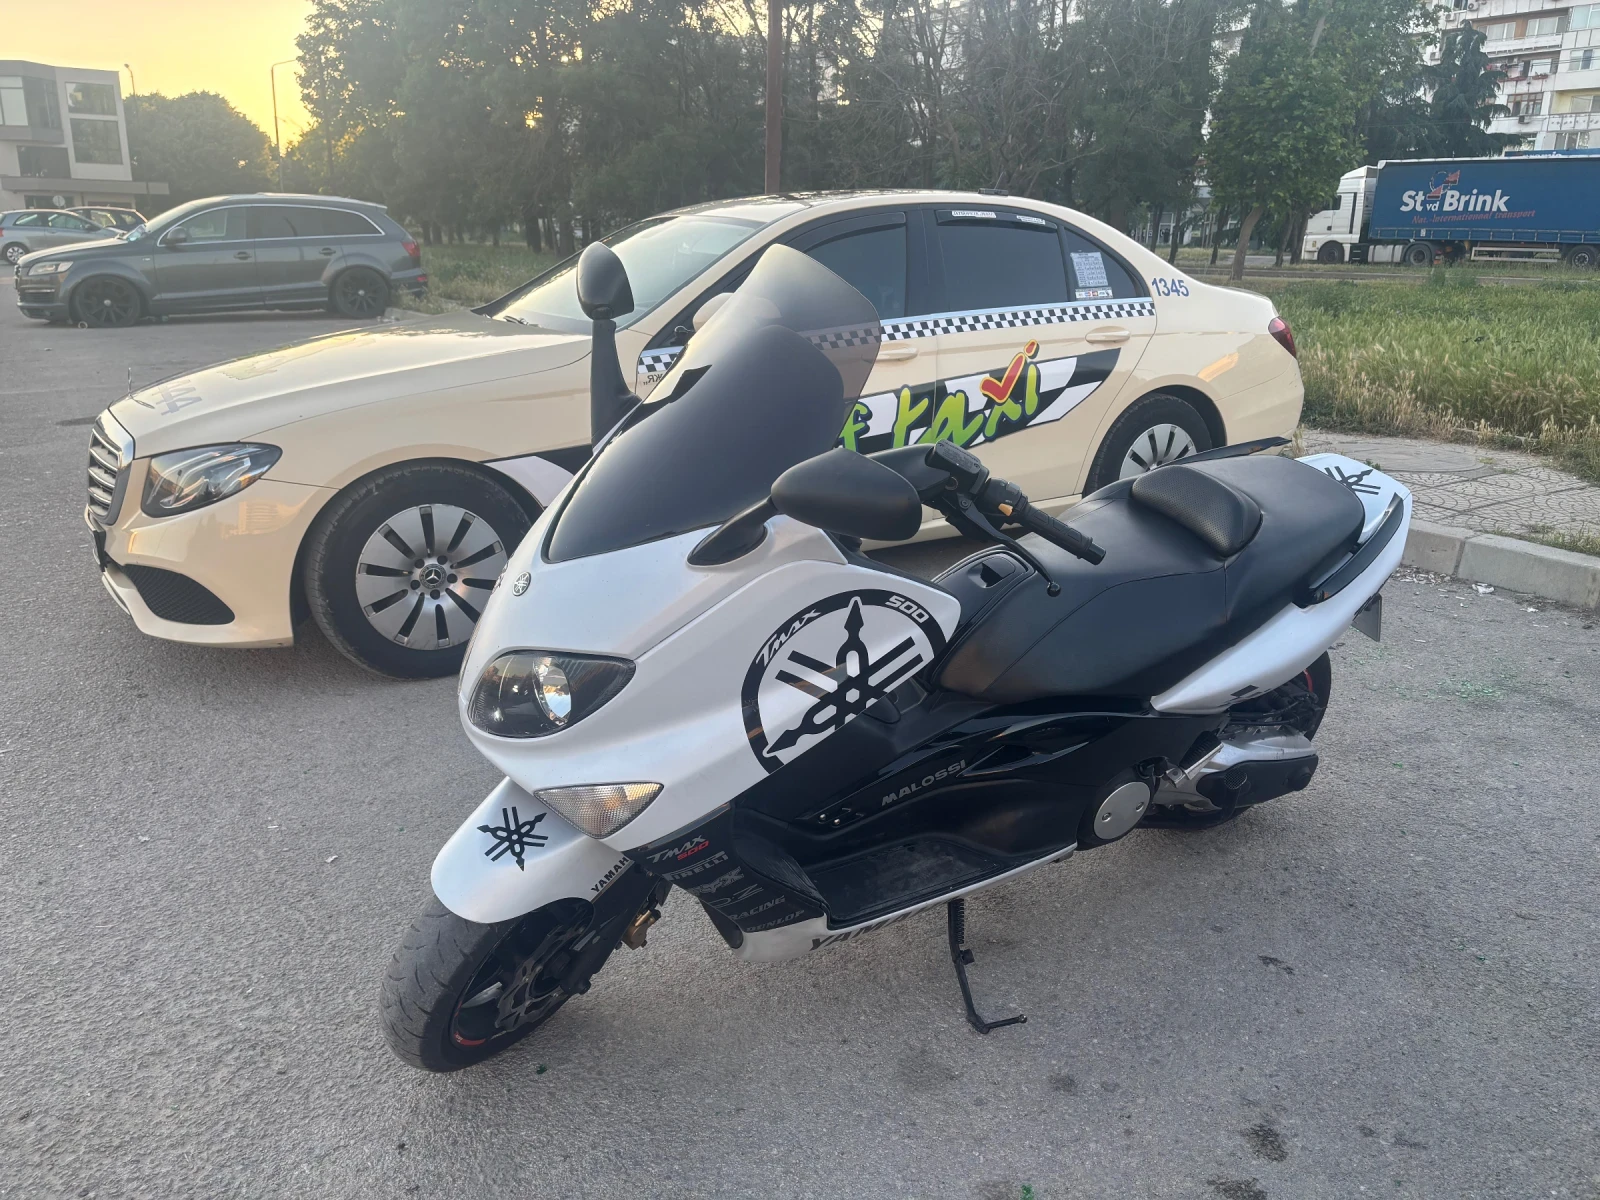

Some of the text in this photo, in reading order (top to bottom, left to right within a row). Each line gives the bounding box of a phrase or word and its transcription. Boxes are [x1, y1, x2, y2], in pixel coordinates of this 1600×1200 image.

[1400, 188, 1511, 212] St vd Brink
[1151, 277, 1190, 298] 1345
[884, 594, 930, 624] 500
[881, 759, 966, 807] MALOSSI
[646, 834, 707, 864] TMAX
[677, 840, 710, 861] 500
[661, 850, 729, 882] PIRELLI
[728, 894, 786, 921] RACING
[745, 909, 805, 932] DUNLOP
